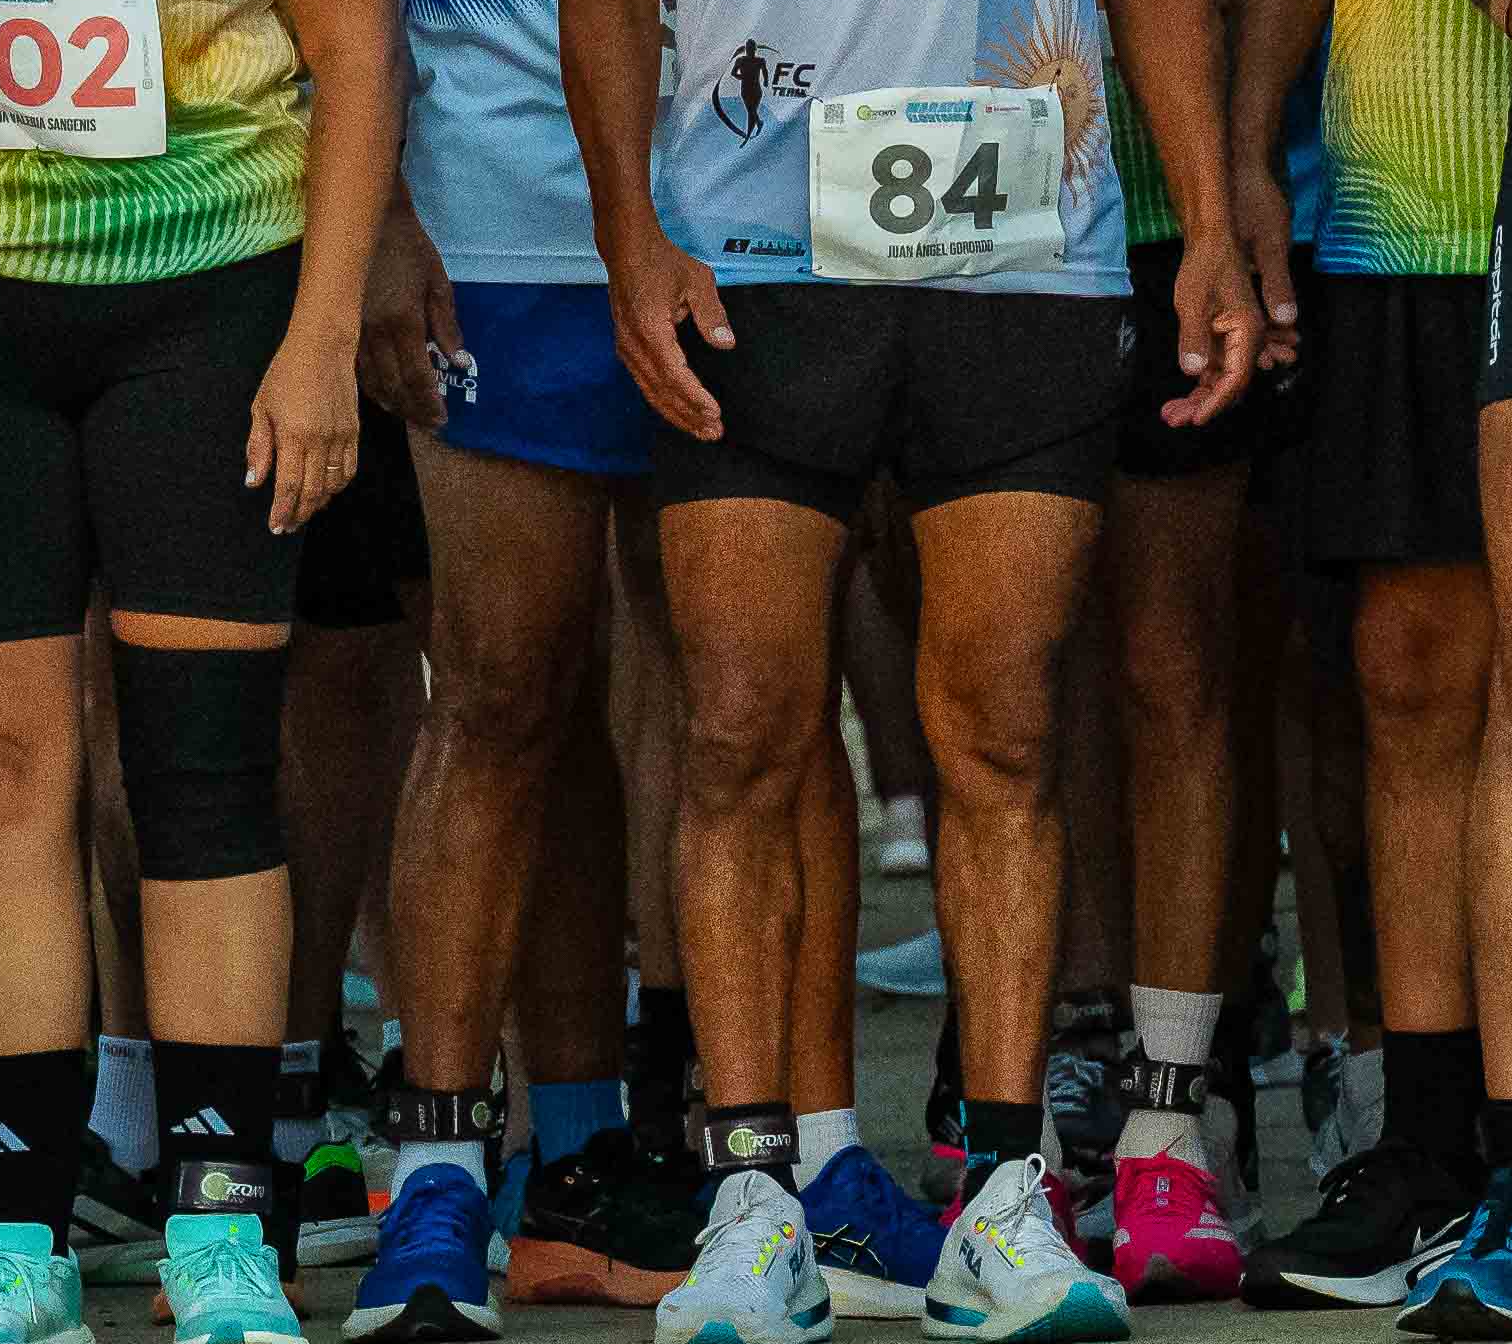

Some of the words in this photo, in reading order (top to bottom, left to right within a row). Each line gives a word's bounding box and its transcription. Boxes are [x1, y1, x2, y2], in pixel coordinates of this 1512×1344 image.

[772, 62, 817, 87] FC
[869, 142, 1009, 235] 84
[886, 244, 914, 258] JUAN
